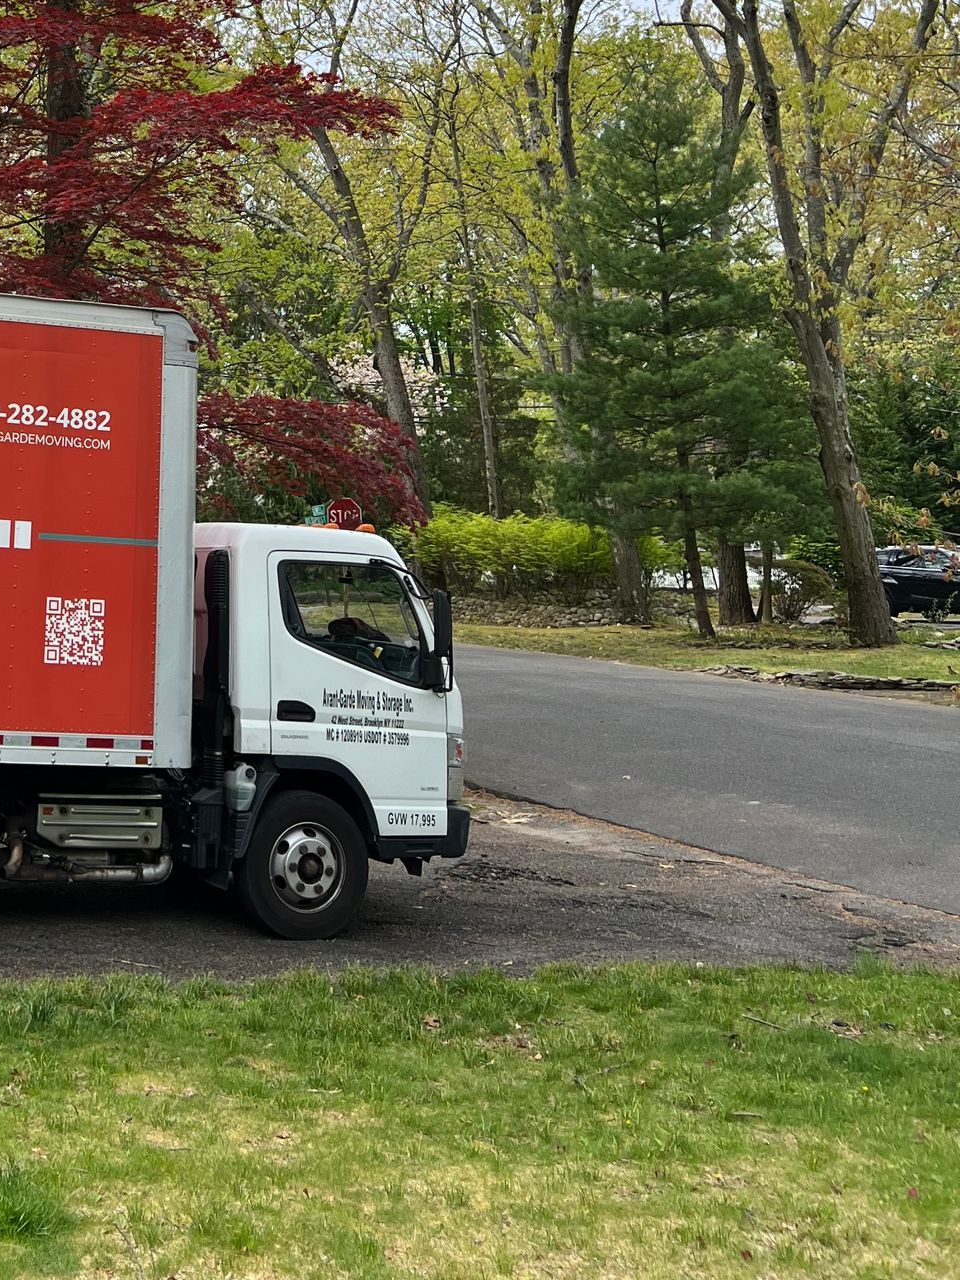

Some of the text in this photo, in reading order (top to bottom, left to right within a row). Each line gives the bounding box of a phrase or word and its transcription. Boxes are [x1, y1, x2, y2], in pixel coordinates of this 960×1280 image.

[323, 688, 355, 710] Avant-Garde
[356, 690, 375, 715] Moving
[382, 691, 402, 717] Storage
[404, 693, 414, 712] Inc.
[331, 715, 337, 724] 42
[338, 716, 348, 725] West
[364, 717, 383, 729] Brooklyn
[384, 718, 391, 728] NY
[326, 728, 334, 741] MC
[364, 730, 381, 744] USDOT
[388, 813, 436, 827] GVW 17,995
